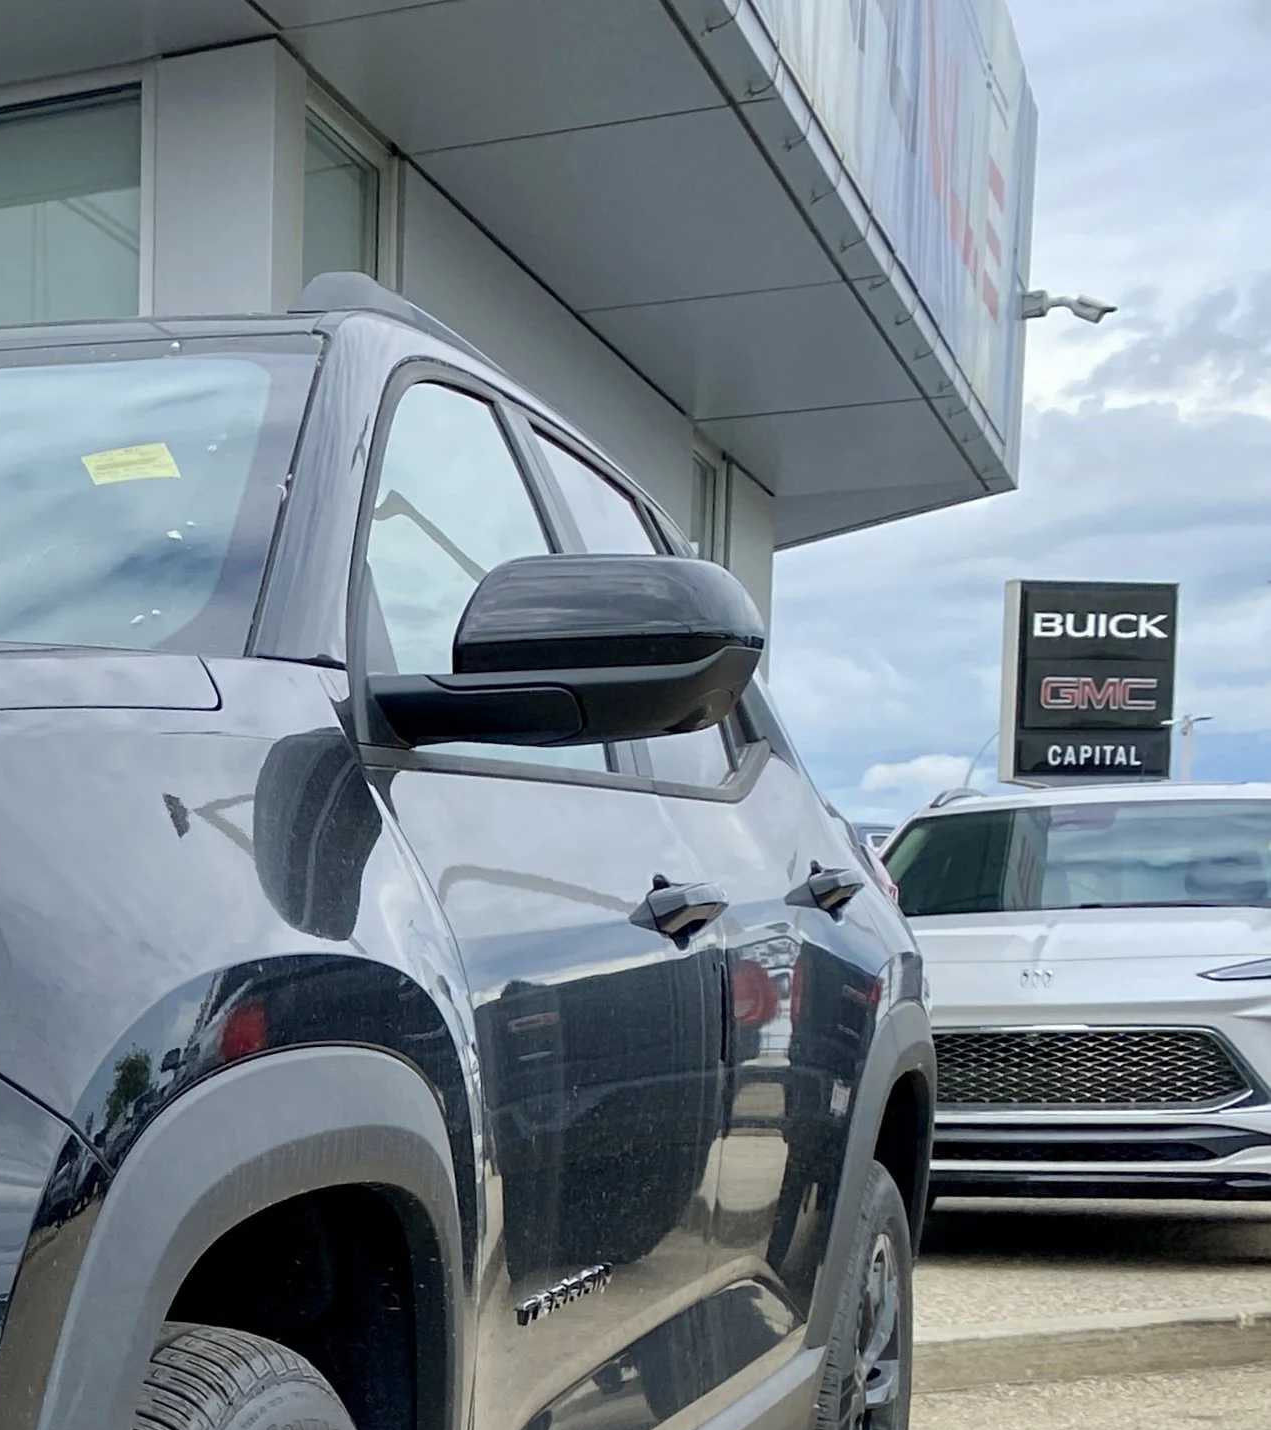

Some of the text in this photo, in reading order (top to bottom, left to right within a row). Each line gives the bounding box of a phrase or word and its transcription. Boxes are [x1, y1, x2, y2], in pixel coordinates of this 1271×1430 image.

[1032, 612, 1169, 639] BUICK
[1040, 676, 1158, 711] GMC
[1047, 744, 1143, 767] CAPITAL
